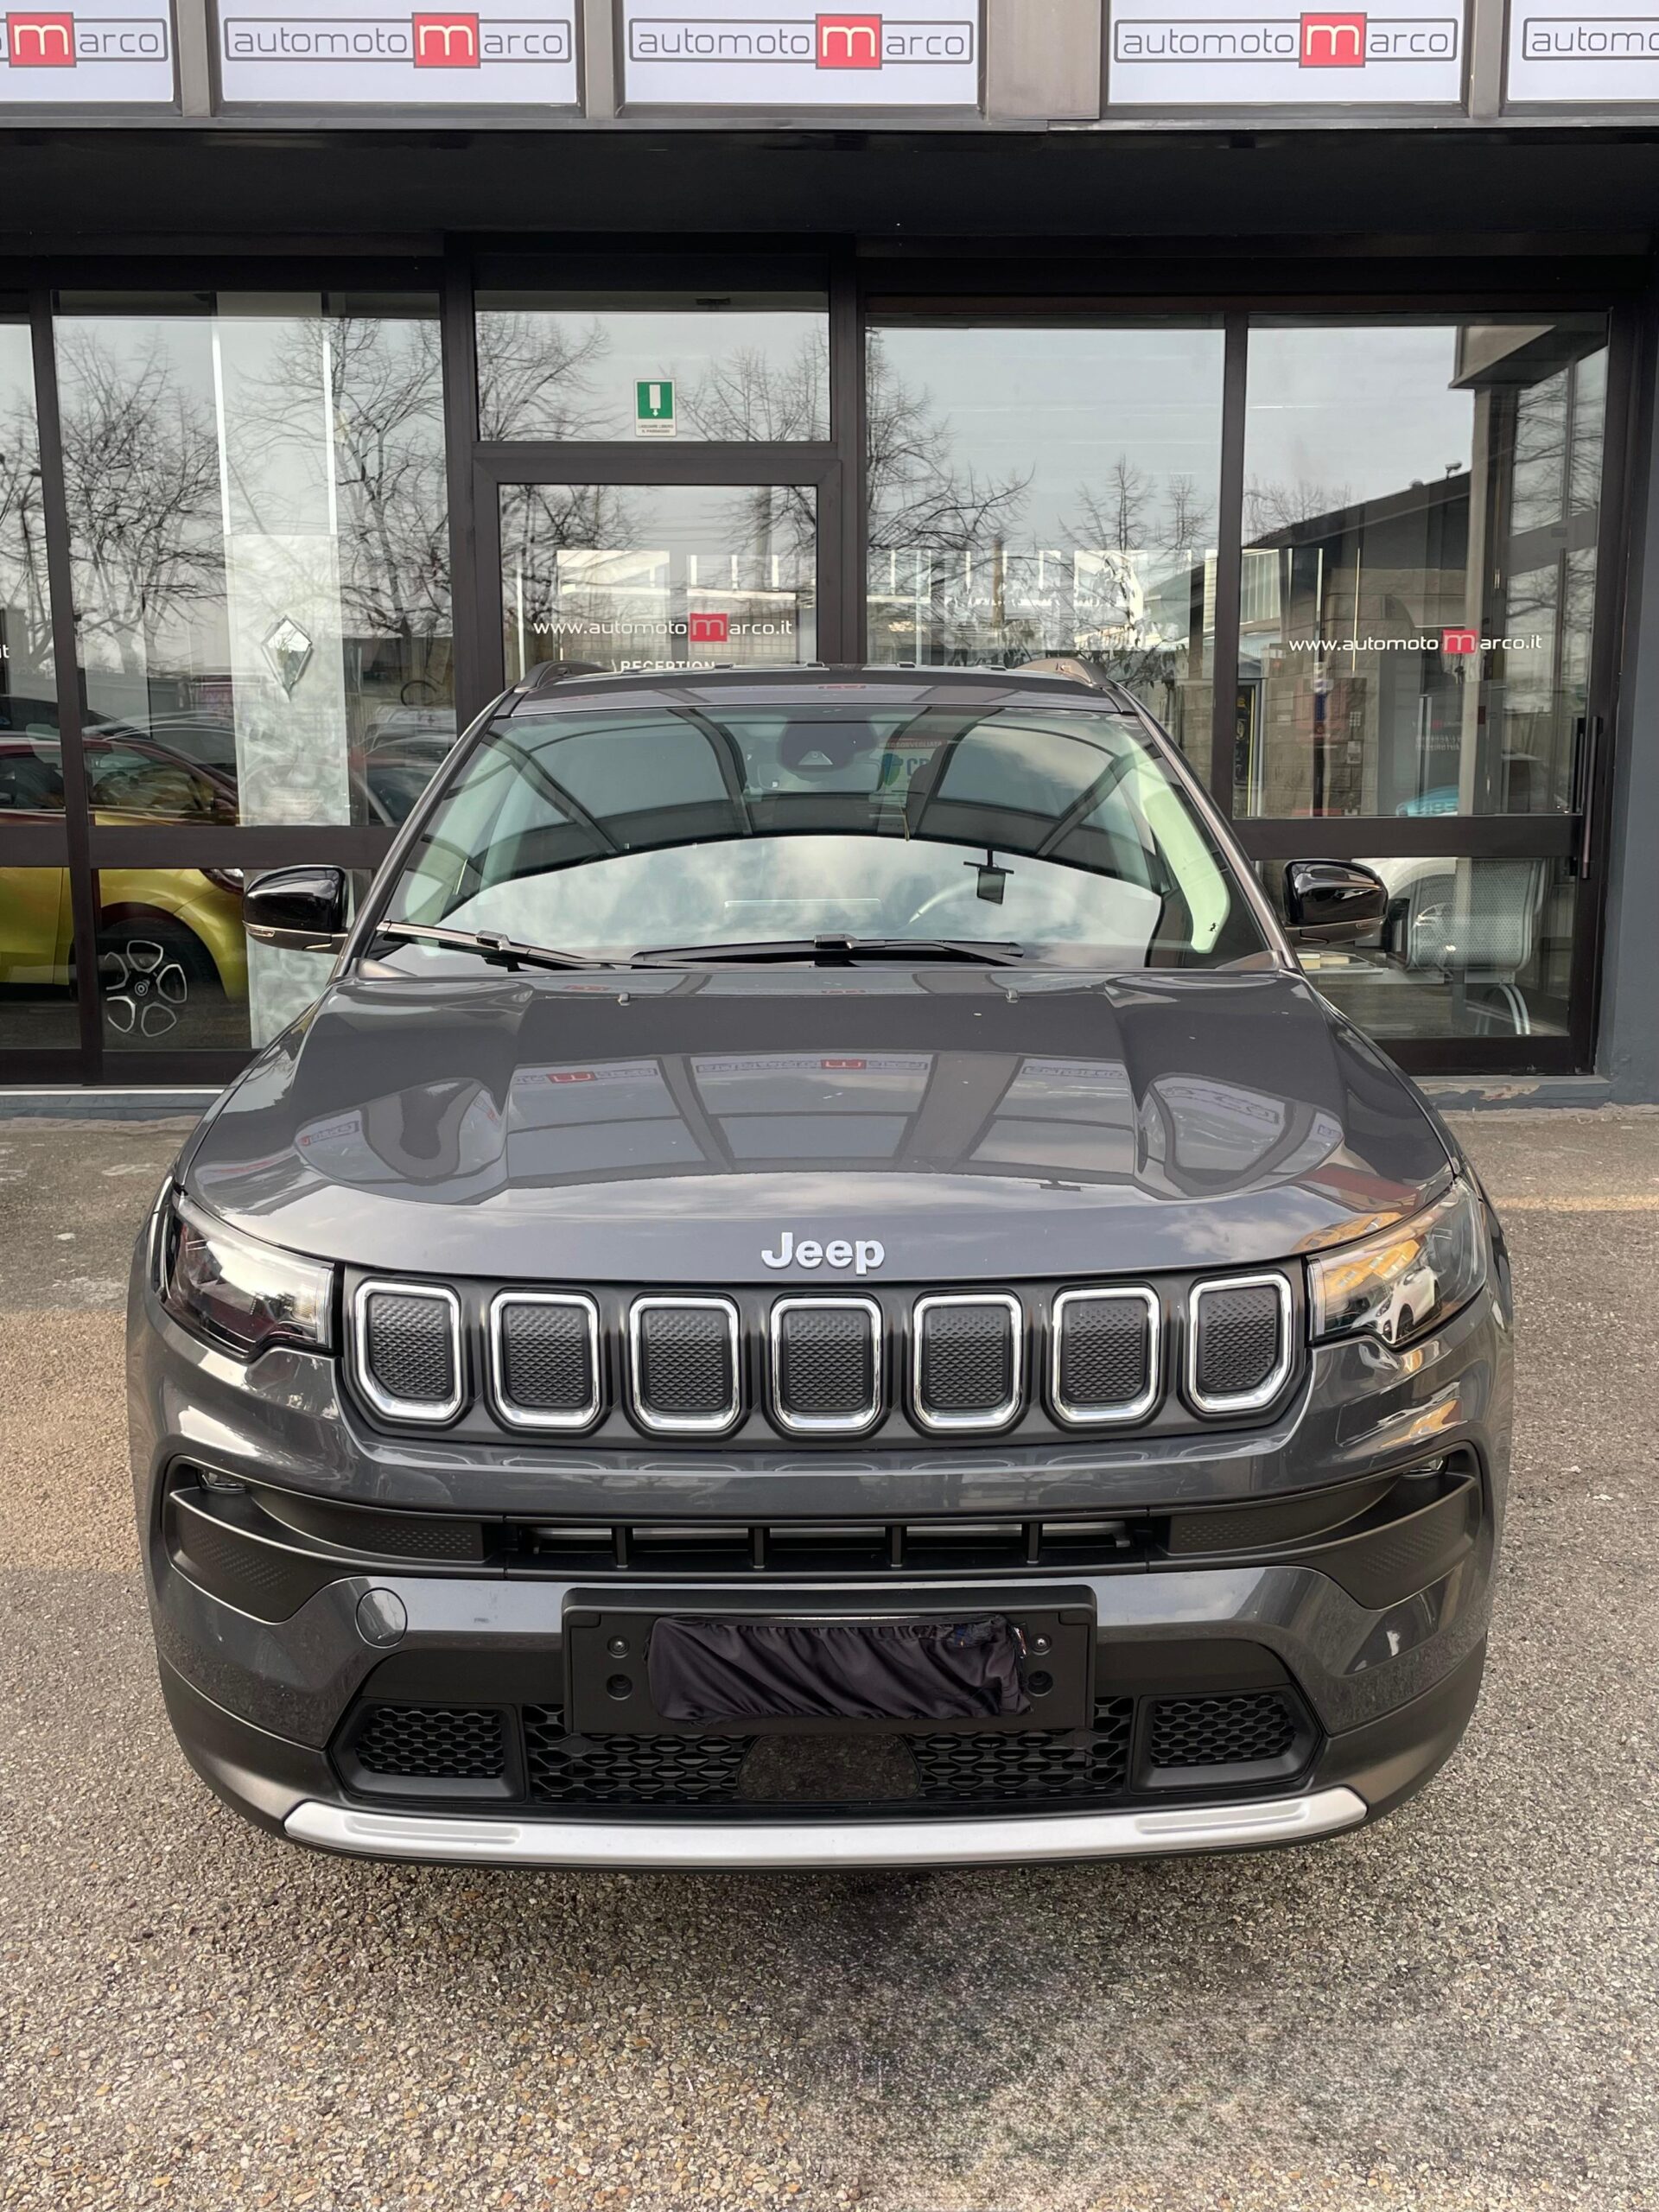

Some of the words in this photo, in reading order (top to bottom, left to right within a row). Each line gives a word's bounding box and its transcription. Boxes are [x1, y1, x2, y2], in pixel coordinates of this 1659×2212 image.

[0, 24, 158, 55] marco
[234, 23, 563, 55] automotomarco
[639, 24, 965, 58] automotomarco
[1123, 23, 1448, 55] automotomarco
[533, 619, 792, 636] www.automotomarco.it
[1289, 634, 1542, 651] www.automotomarco.it
[761, 1232, 885, 1275] Jeep
